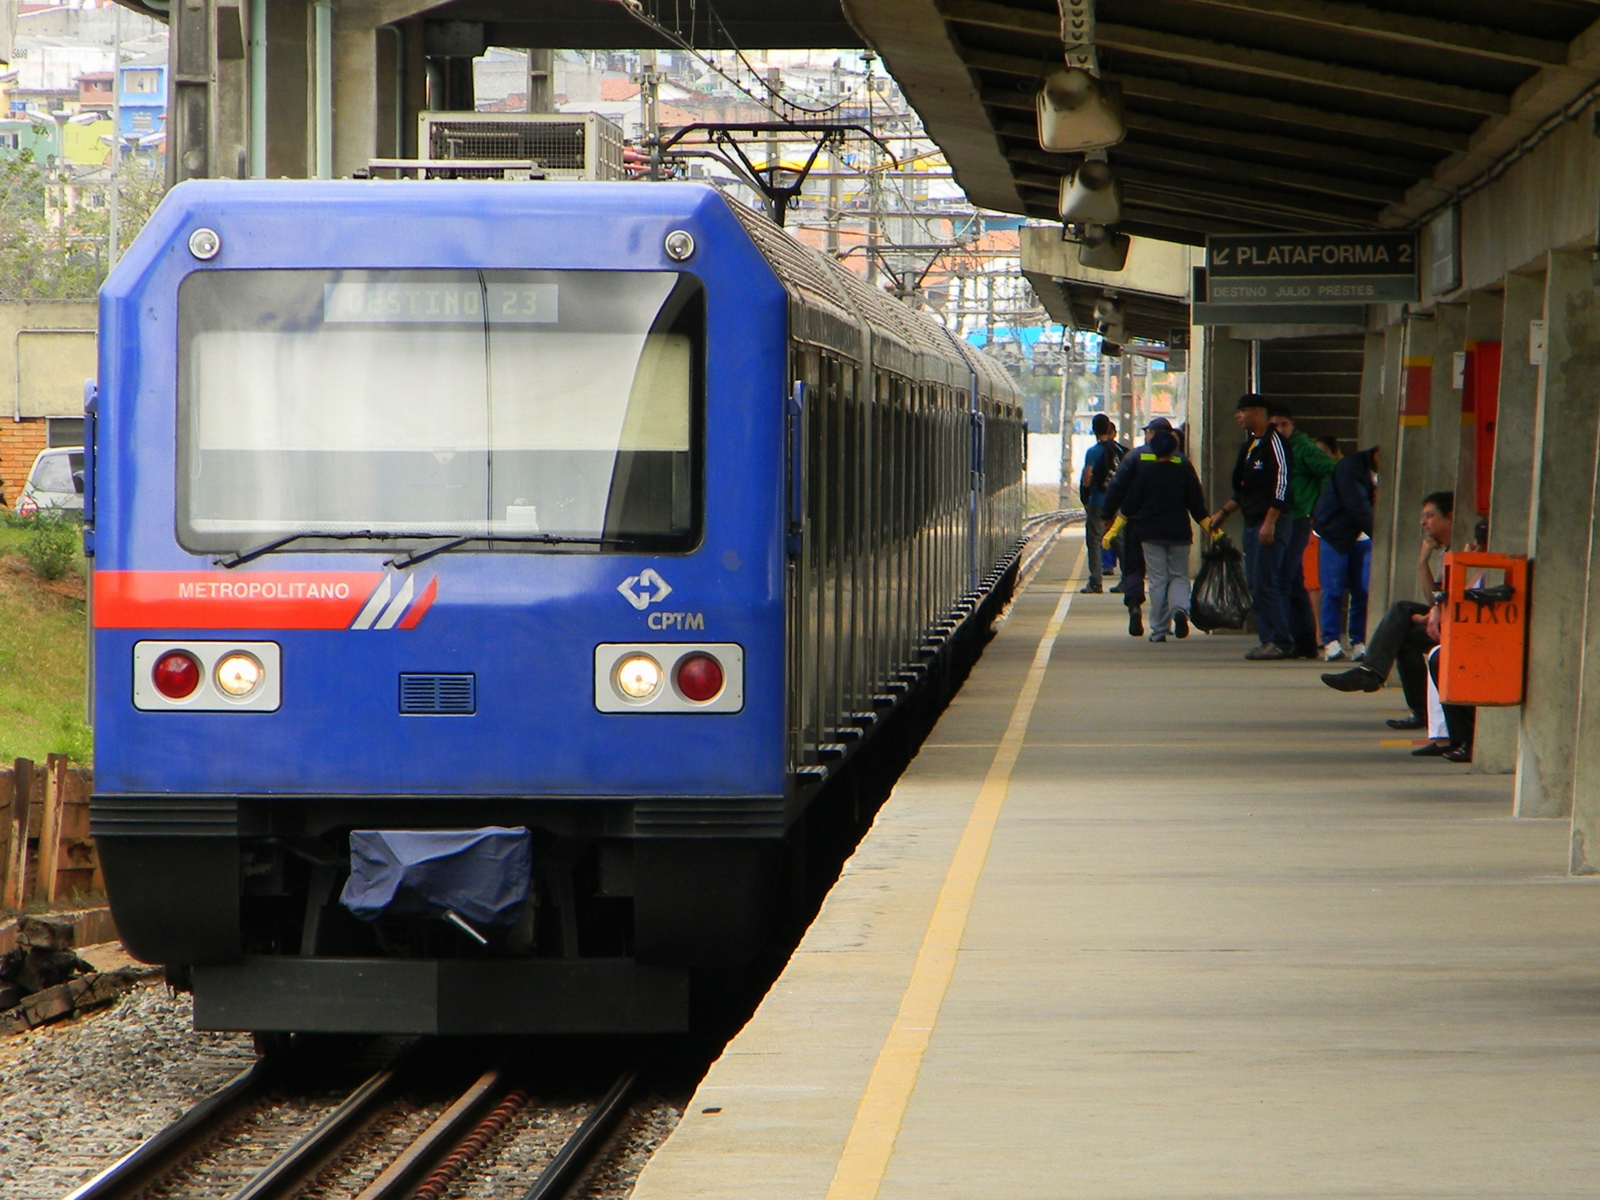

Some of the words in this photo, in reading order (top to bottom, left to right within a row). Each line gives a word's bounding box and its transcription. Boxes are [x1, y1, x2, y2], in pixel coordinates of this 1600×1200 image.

[1236, 245, 1389, 265] PLATAFORMA
[1398, 244, 1412, 262] 2
[1213, 286, 1268, 298] DESTINO
[1275, 285, 1311, 297] JULIO
[1318, 285, 1374, 296] PRESTES
[502, 291, 537, 315] 23
[178, 582, 350, 599] METROPOLITANO
[647, 612, 705, 631] CPTM
[1453, 602, 1518, 624] LIXO
